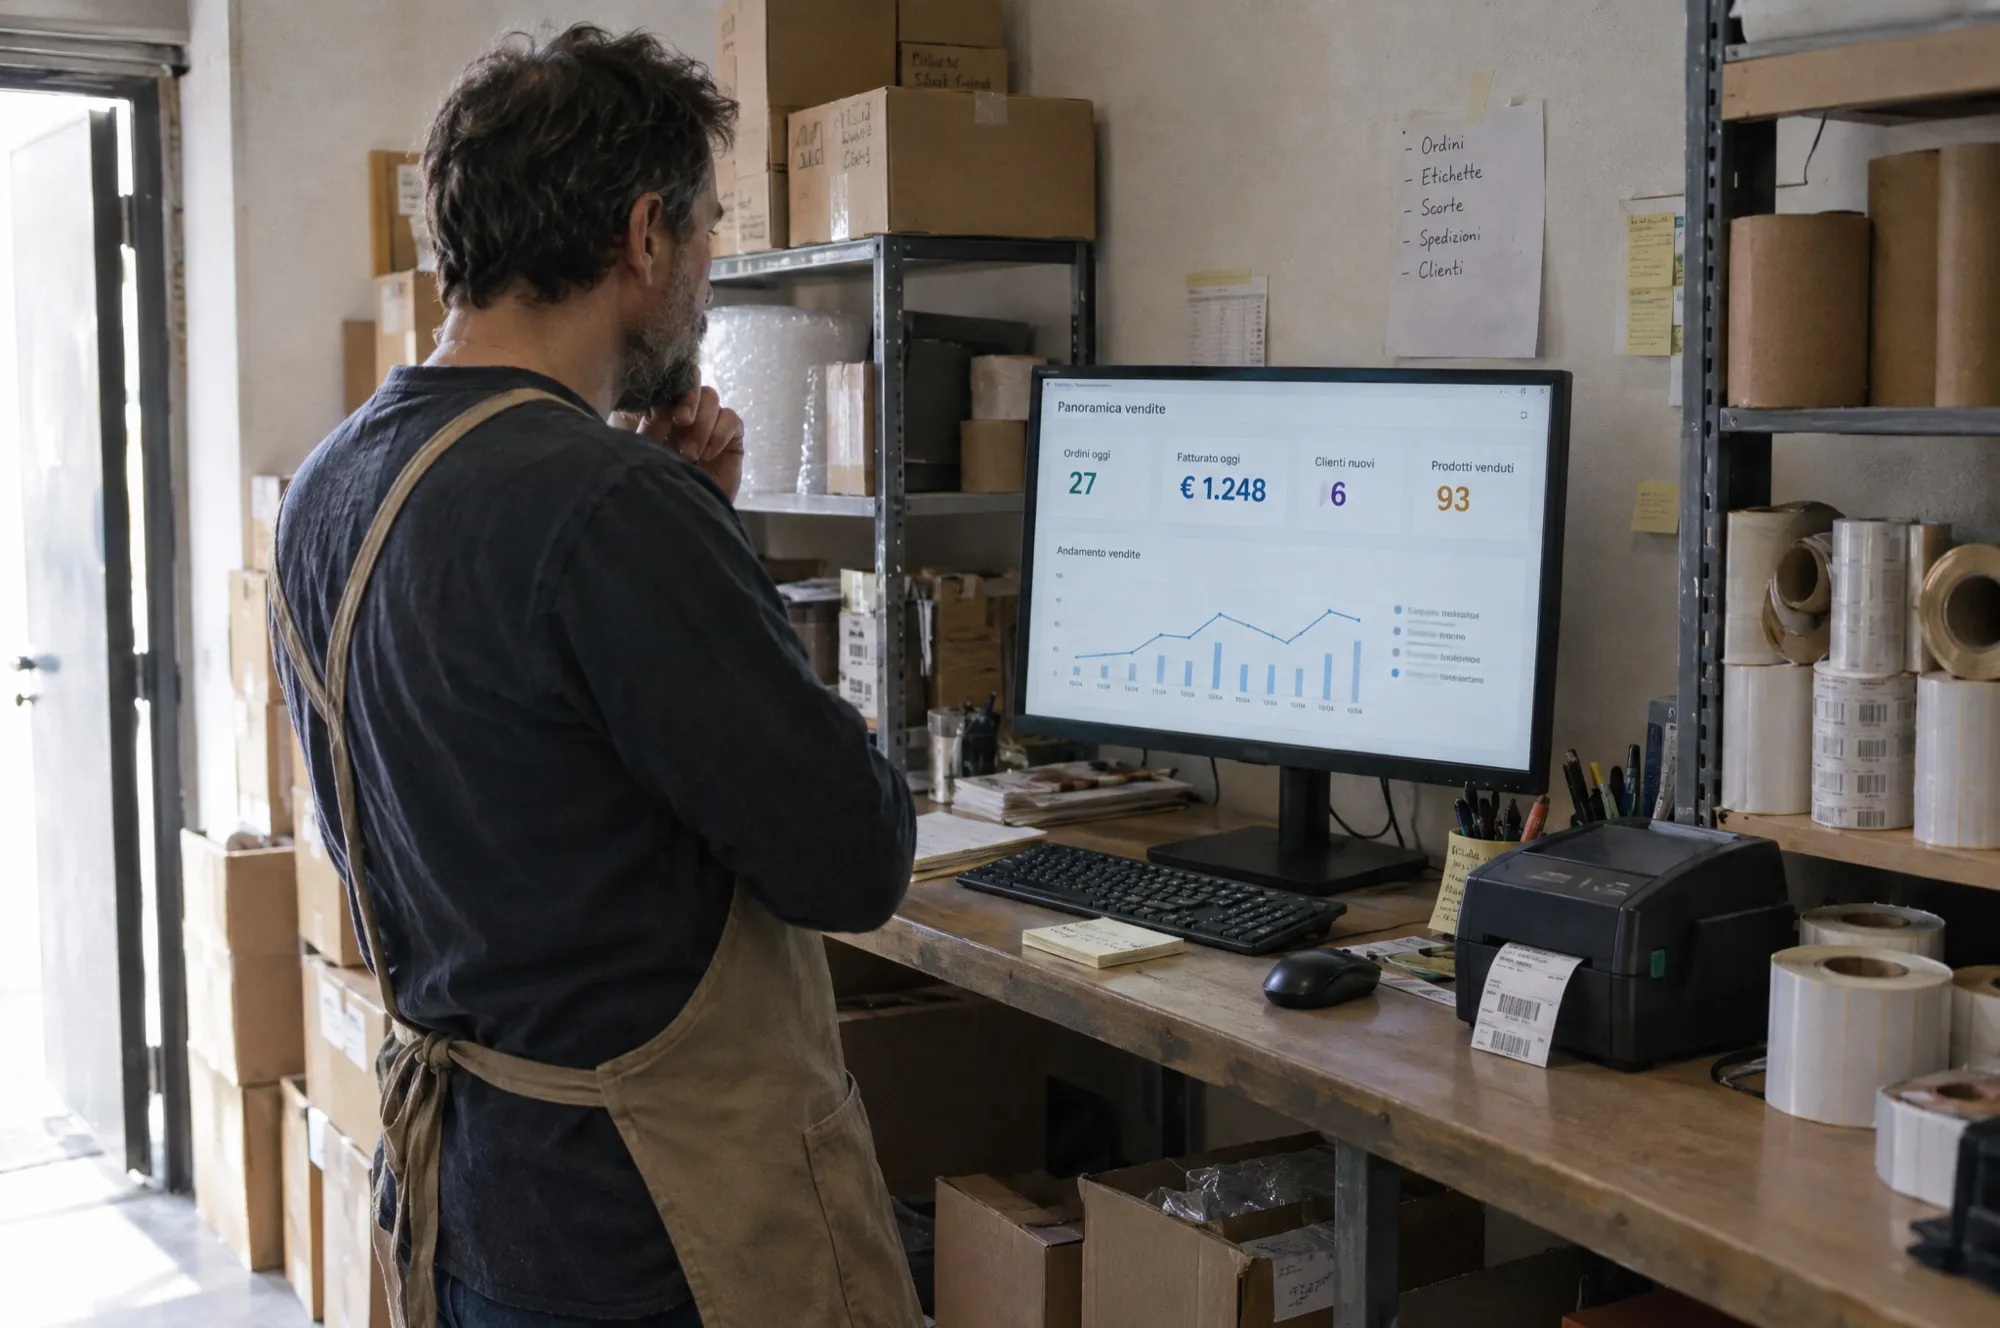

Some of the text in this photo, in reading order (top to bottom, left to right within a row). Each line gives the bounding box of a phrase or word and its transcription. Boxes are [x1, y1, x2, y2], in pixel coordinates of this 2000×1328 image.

[1422, 135, 1463, 154] Ordini
[1422, 163, 1482, 186] Etichette
[1422, 197, 1463, 216] Scorte
[1420, 226, 1480, 251] Spedizioni
[1419, 260, 1463, 279] Clienti
[1058, 401, 1165, 414] Panoramica vendite
[1064, 449, 1110, 461] Ordini oggi
[1177, 453, 1240, 466] Fatturato oggi
[1315, 457, 1374, 468] Clienti nuovi
[1432, 461, 1514, 473] Prodotti venduti
[1069, 471, 1096, 495] 27
[1180, 476, 1266, 502] € 1.248
[1331, 482, 1346, 506] 6
[1437, 486, 1470, 512] 93
[1057, 546, 1140, 559] Andamento vendite
